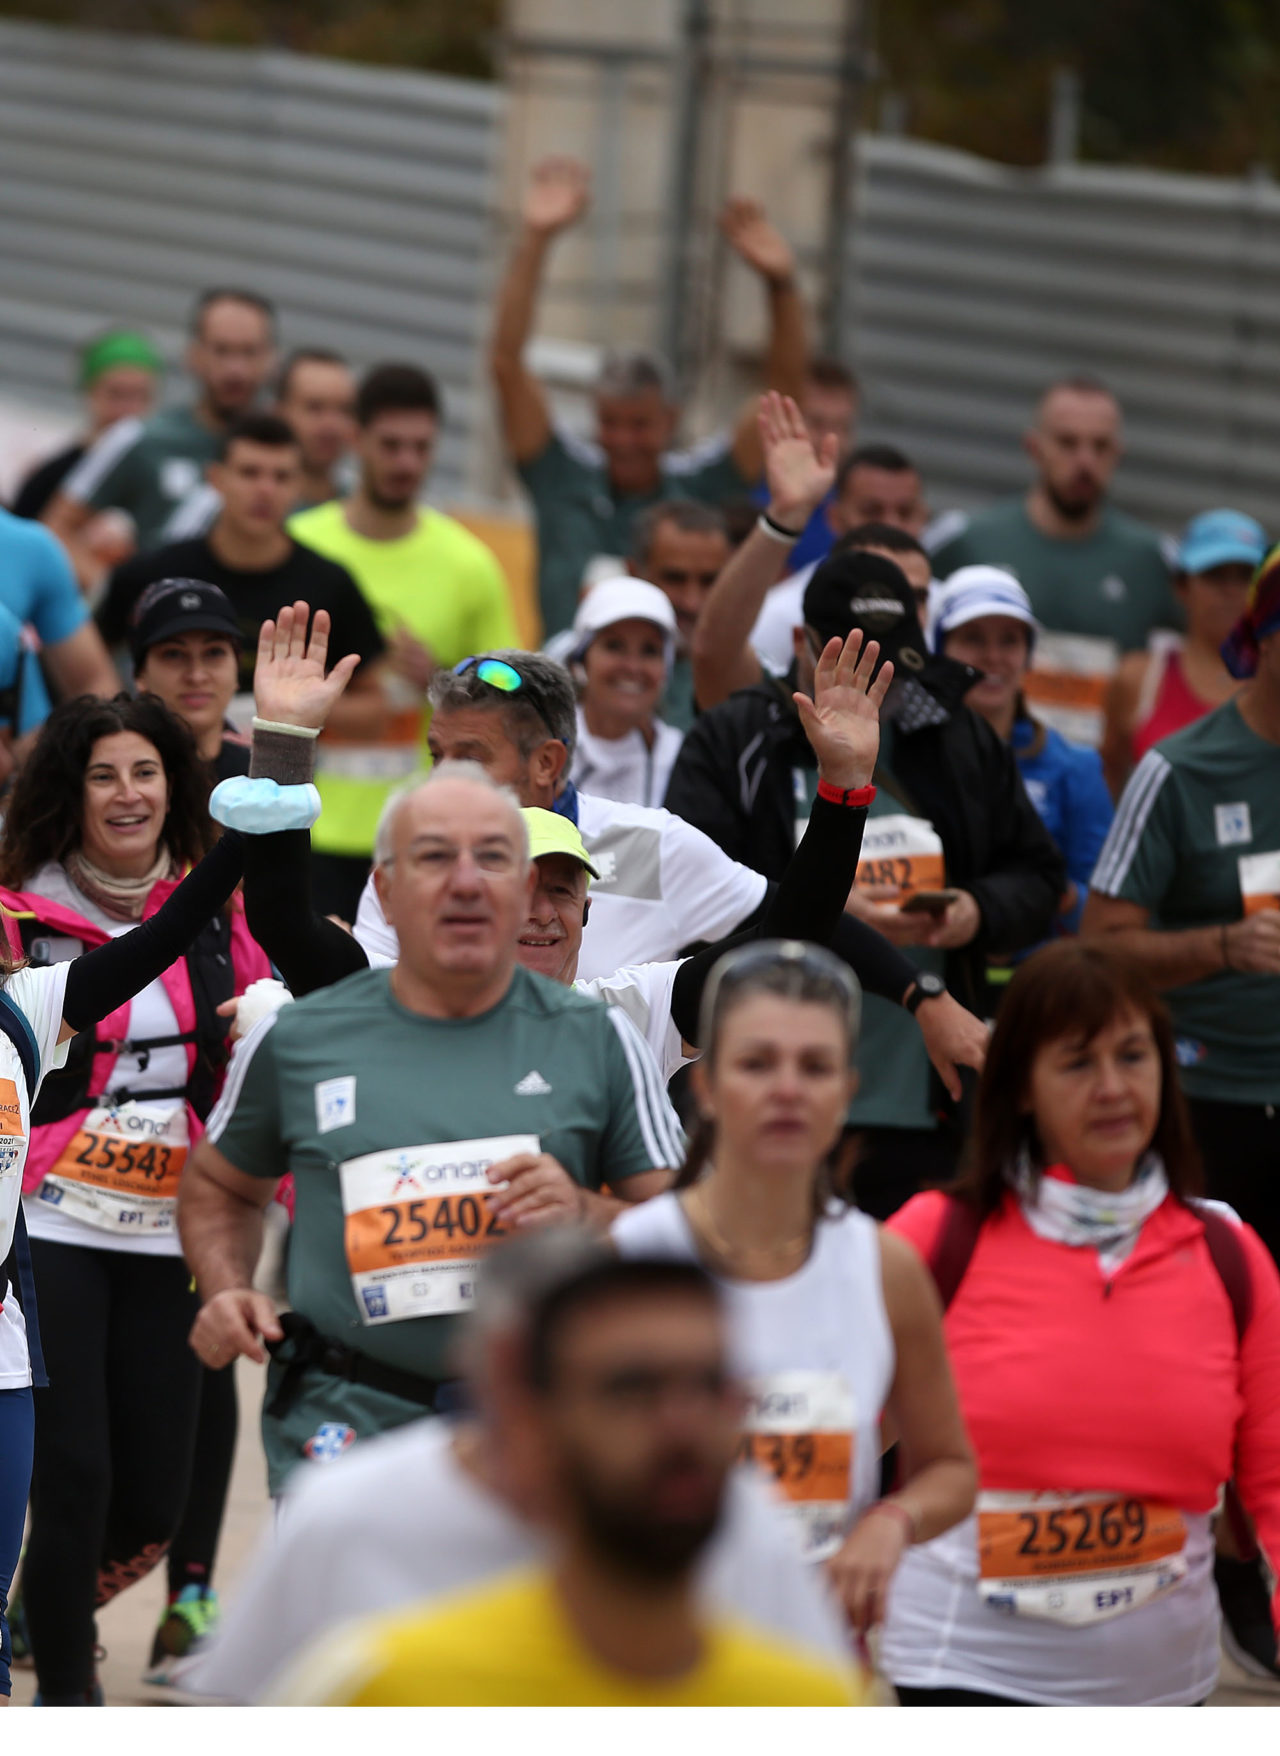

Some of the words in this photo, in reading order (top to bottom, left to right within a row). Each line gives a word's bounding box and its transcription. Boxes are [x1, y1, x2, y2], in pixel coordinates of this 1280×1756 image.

[860, 858, 912, 889] 482
[0, 1137, 14, 1145] 2021
[76, 1133, 172, 1181] 25543
[1018, 1499, 1146, 1555] 25269
